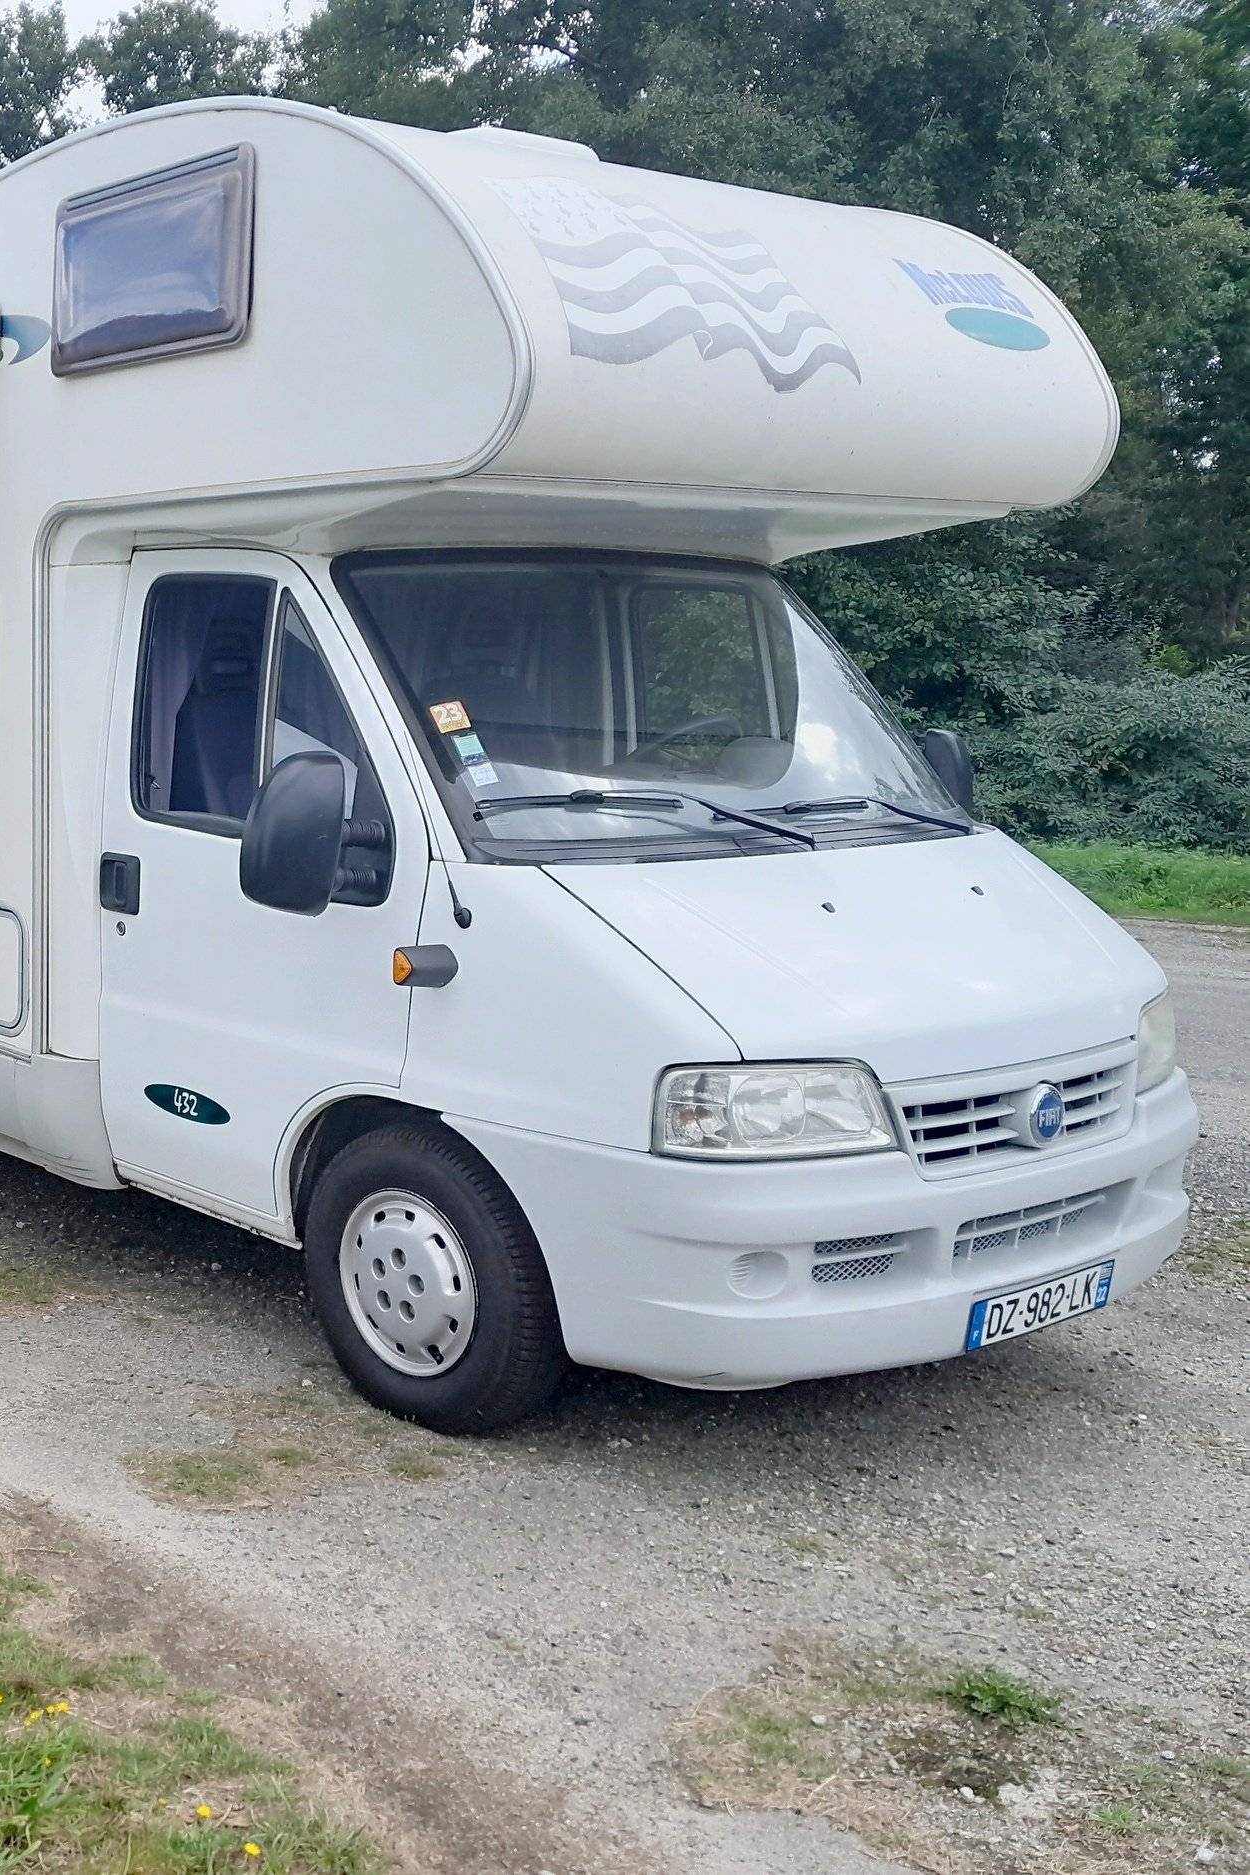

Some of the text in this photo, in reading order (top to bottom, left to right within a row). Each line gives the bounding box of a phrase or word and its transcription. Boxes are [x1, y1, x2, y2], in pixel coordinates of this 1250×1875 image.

[430, 702, 463, 725] 23
[173, 1088, 199, 1116] 432
[1039, 1106, 1061, 1128] FIAT
[985, 1271, 1098, 1339] DZ-982-LK
[1095, 1285, 1108, 1303] 22
